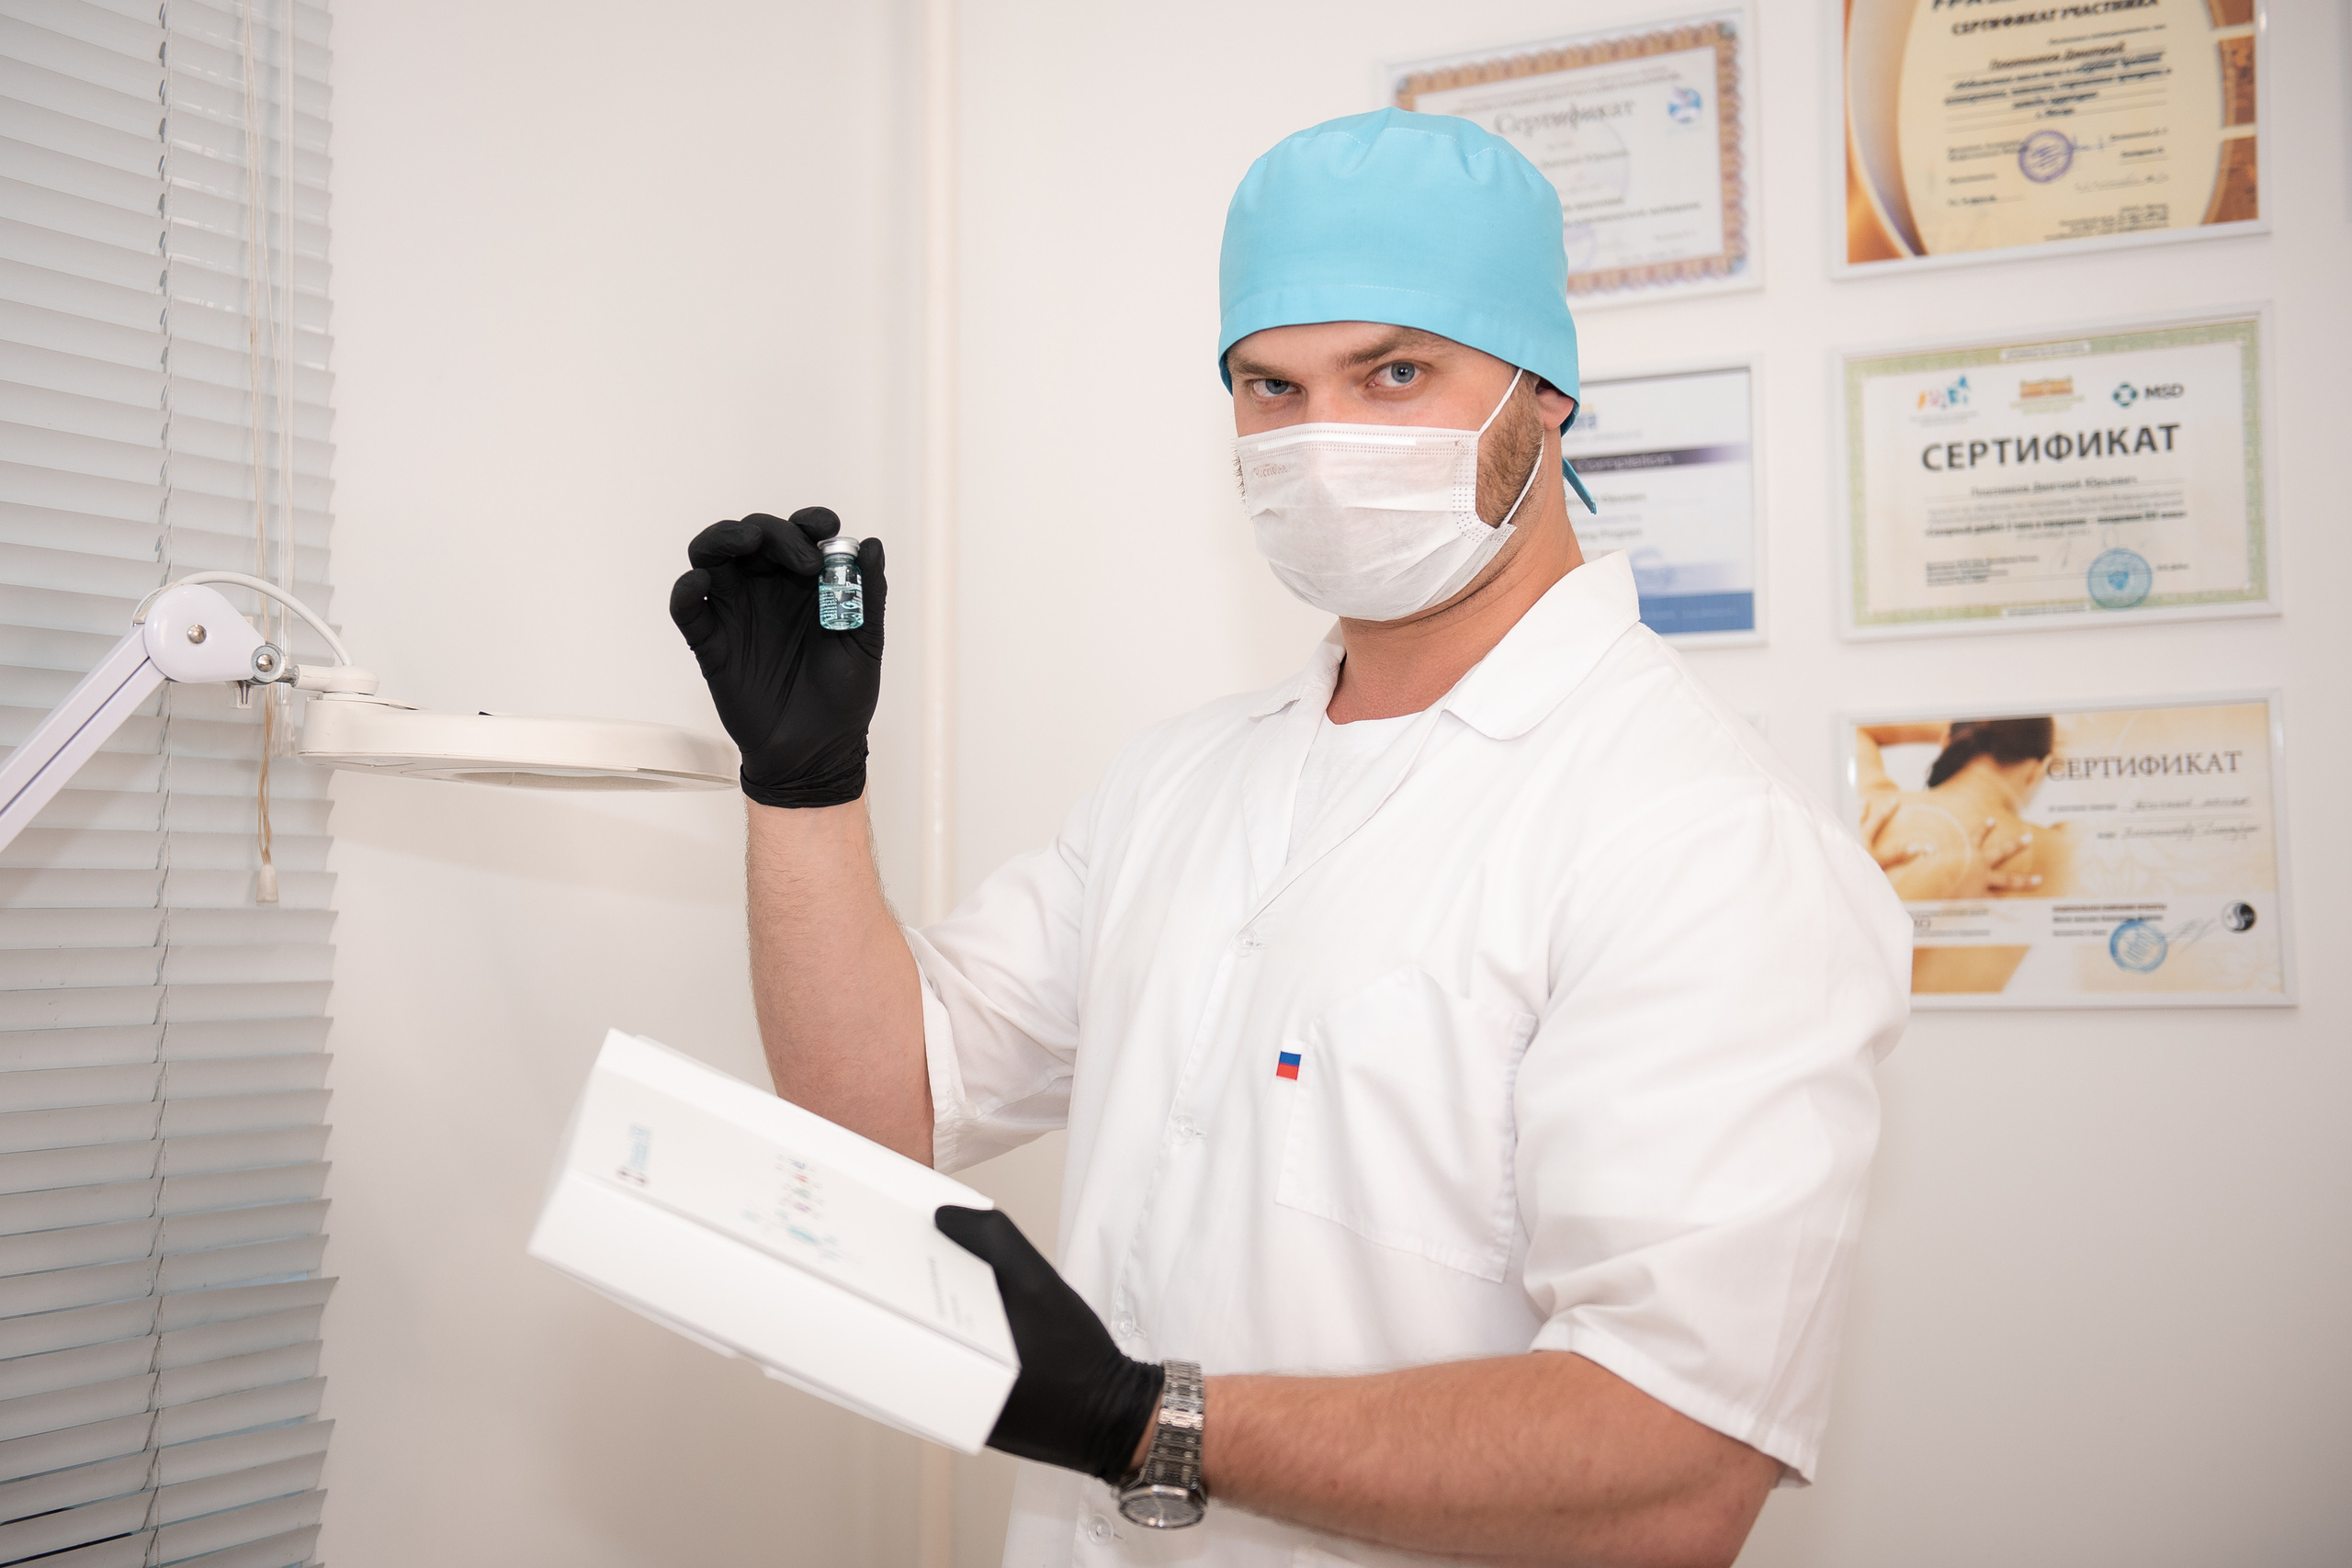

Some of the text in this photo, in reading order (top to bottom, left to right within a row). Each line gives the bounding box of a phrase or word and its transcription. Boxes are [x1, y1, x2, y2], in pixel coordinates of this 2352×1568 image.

[2144, 383, 2185, 399] MSD
[1922, 423, 2180, 471] СЕРТИФИКАТ
[2047, 750, 2244, 781] СЕРТИФИКАТ
